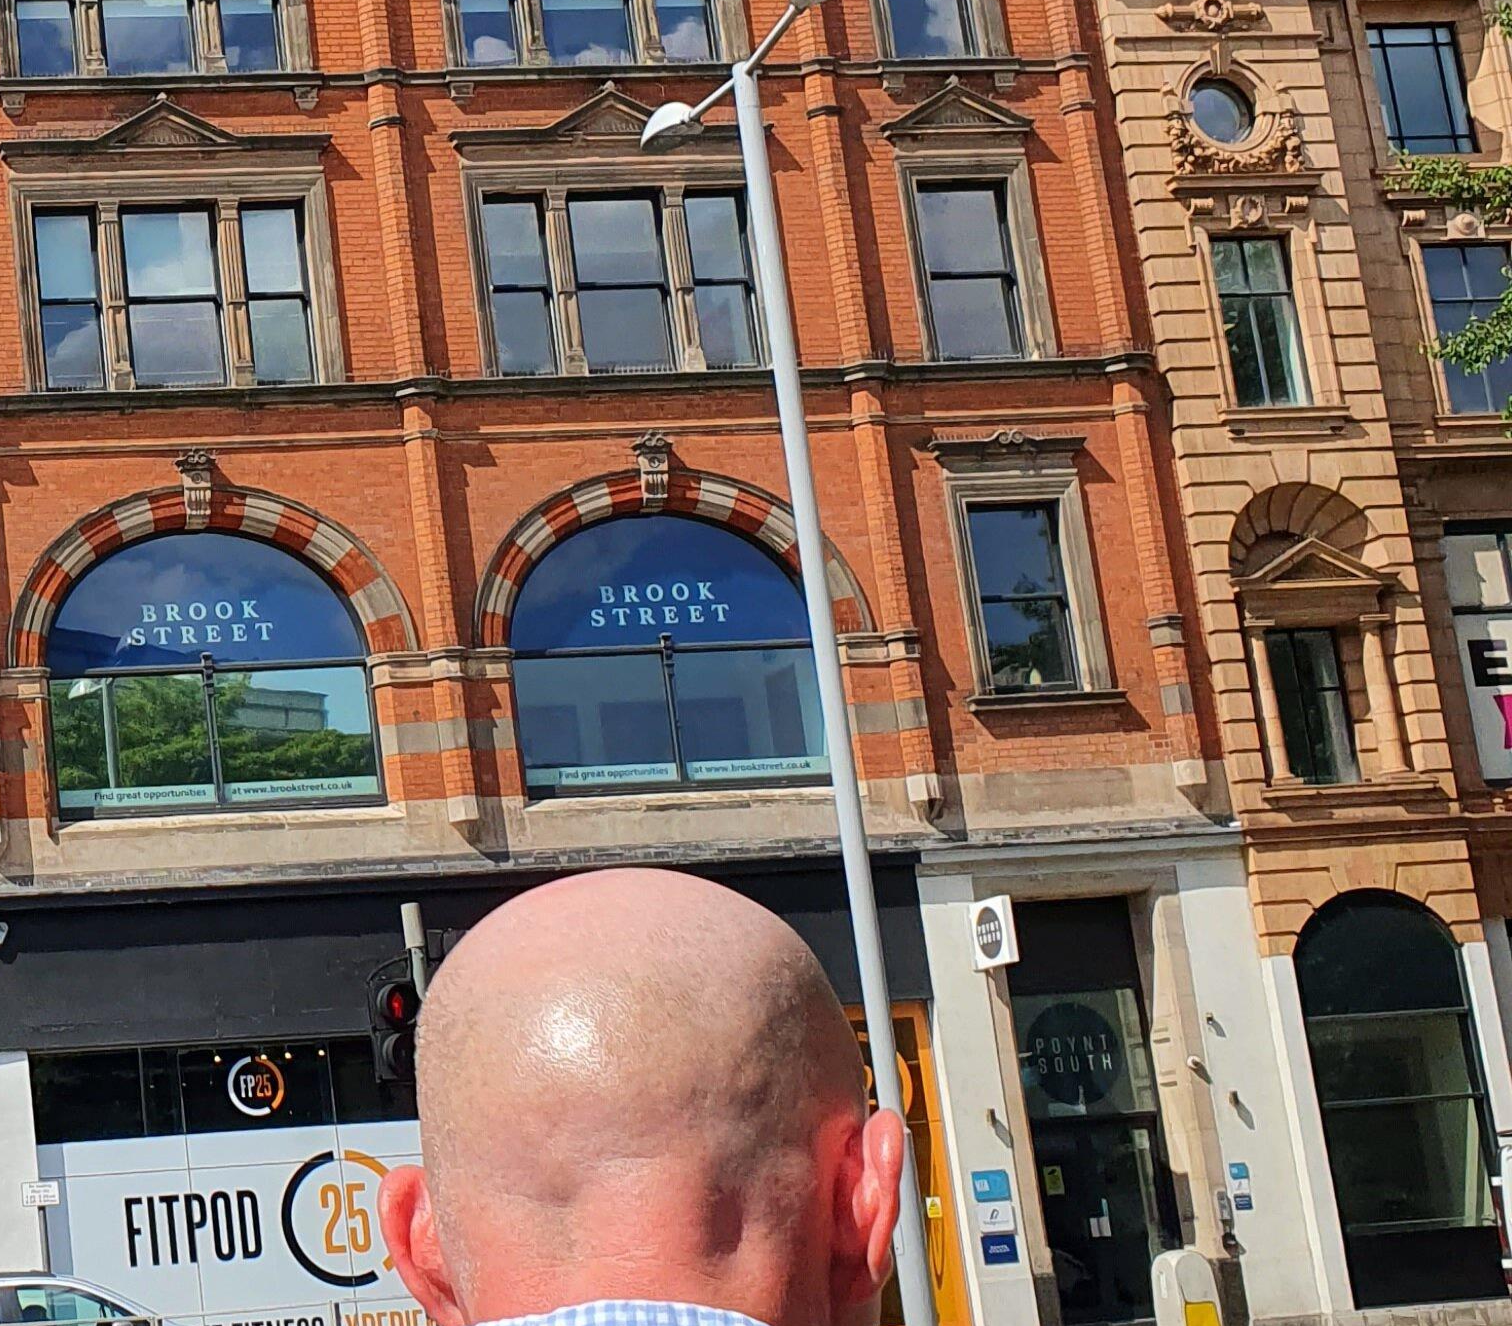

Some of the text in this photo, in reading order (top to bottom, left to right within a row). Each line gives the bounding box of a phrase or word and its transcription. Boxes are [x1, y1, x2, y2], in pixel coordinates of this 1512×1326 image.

[599, 582, 715, 604] BROOK
[141, 600, 260, 623] BROOK
[590, 604, 729, 627] STREET
[131, 622, 274, 646] STREET
[581, 769, 605, 781] great
[94, 788, 207, 803] Find great opportunities
[243, 780, 353, 795] www.brookstreet.co.uk
[1035, 1034, 1106, 1055] POYNT
[1038, 1052, 1112, 1074] SOUTH
[240, 1074, 272, 1098] FP25
[125, 1182, 372, 1267] FITPOD 25
